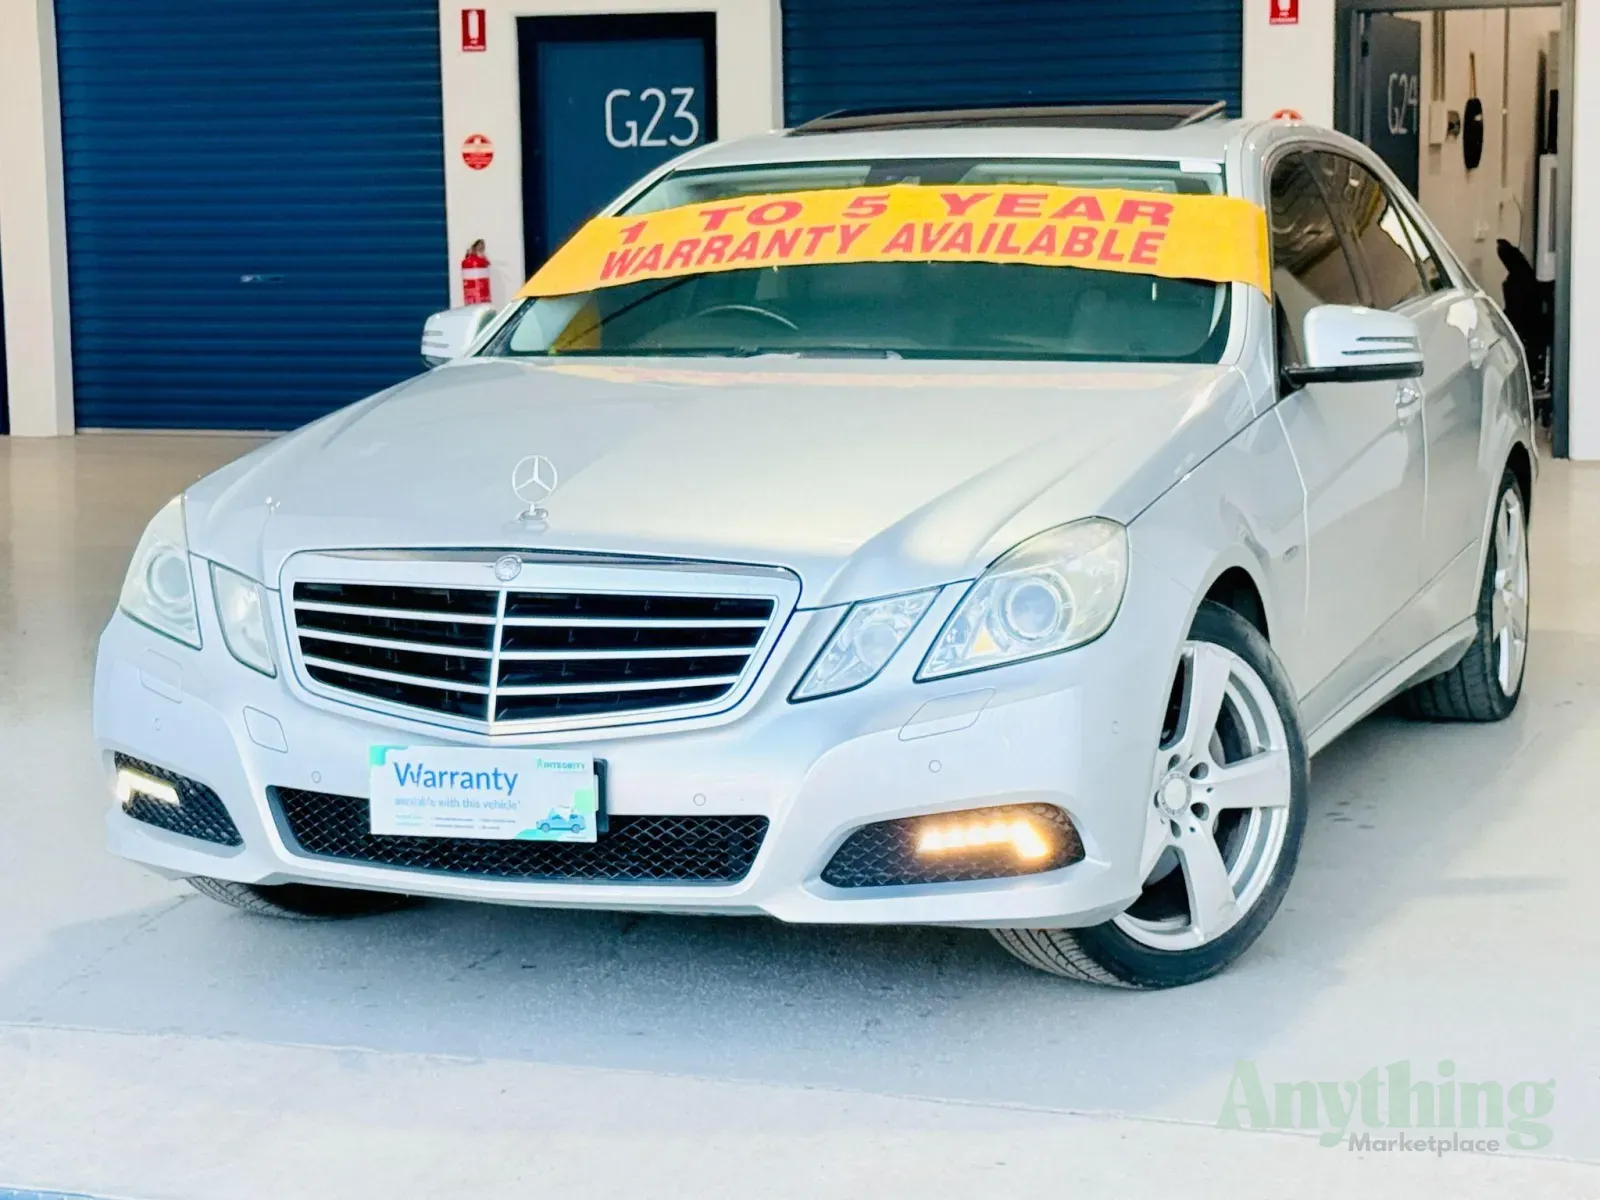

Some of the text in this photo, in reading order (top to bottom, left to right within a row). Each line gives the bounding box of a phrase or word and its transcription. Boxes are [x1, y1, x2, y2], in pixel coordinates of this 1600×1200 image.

[604, 87, 699, 148] G23
[1387, 71, 1418, 136] G24
[618, 192, 1175, 246] 1 TO 5 YEAR
[599, 221, 1167, 281] WARRANTY AVAILABLE
[393, 761, 519, 796] Warranty
[438, 796, 460, 808] with
[462, 797, 481, 809] this
